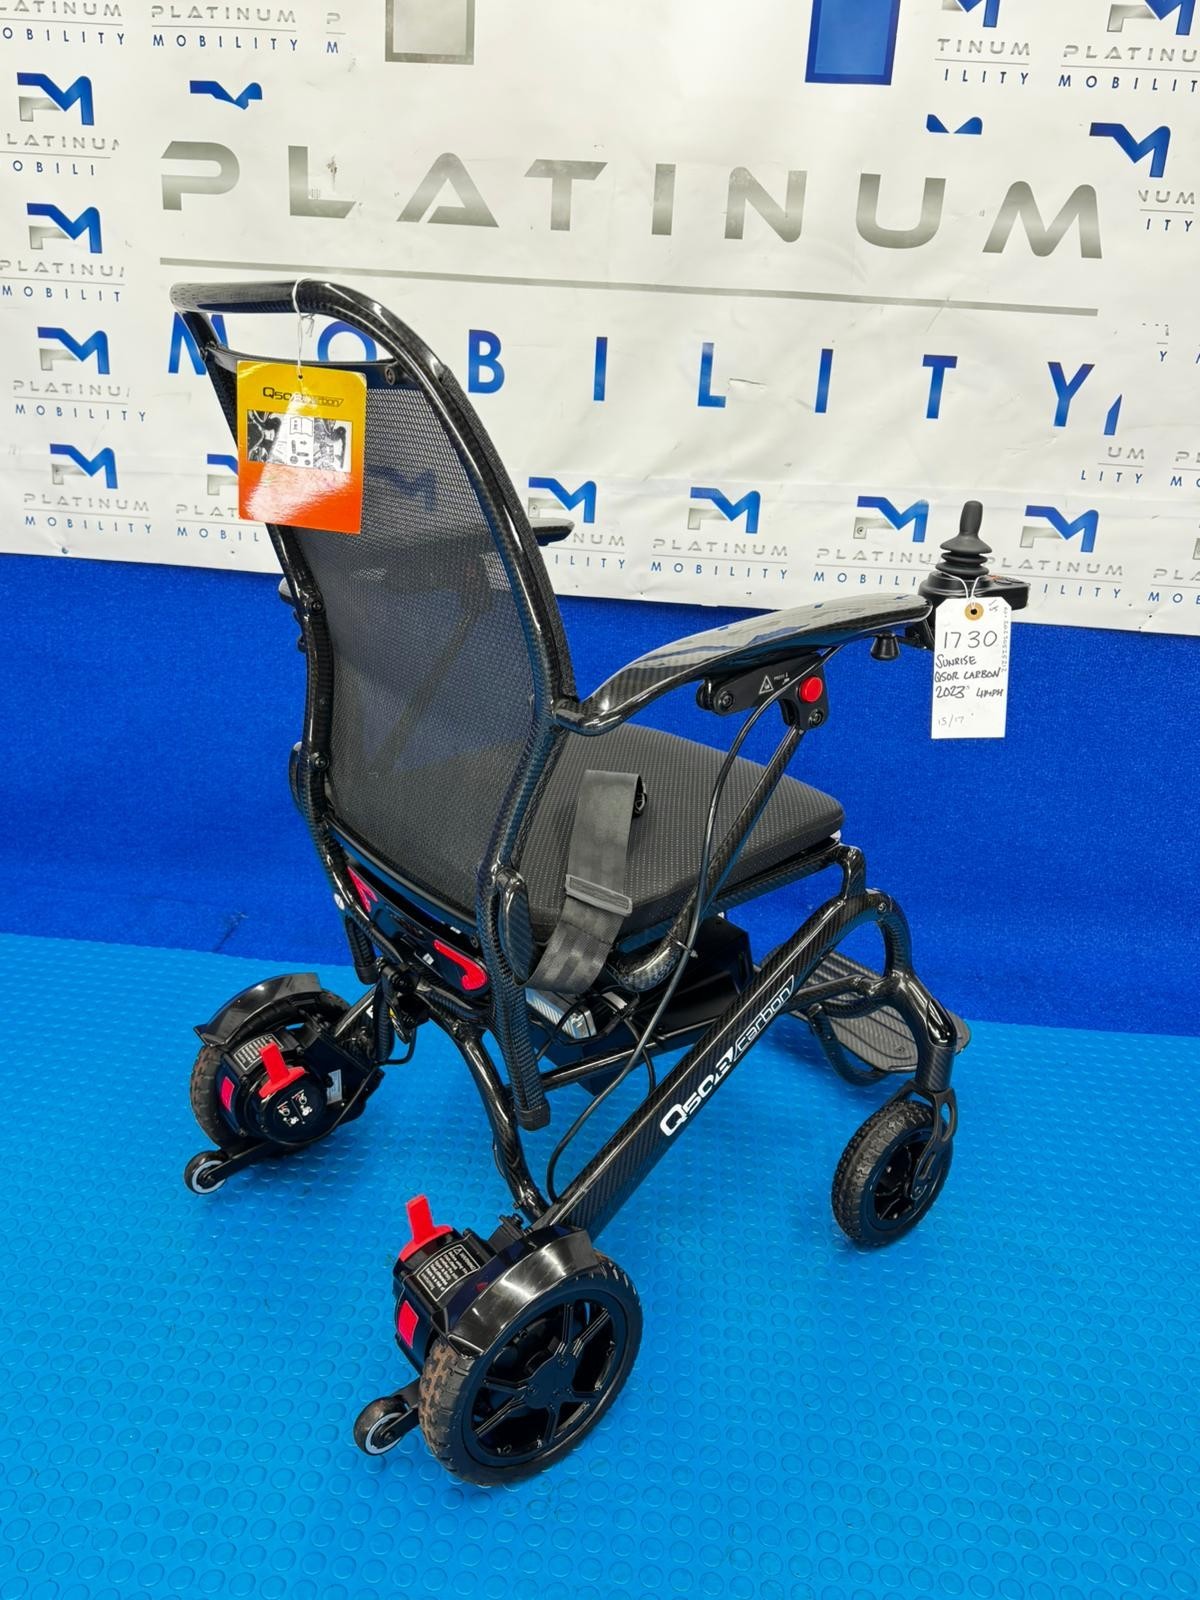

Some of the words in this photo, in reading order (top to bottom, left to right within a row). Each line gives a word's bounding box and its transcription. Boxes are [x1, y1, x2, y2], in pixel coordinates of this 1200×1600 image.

[151, 5, 296, 23] PLATINUM
[2, 27, 125, 46] OBILITY
[153, 34, 298, 51] MOBILITY
[937, 38, 1031, 56] TINUM
[944, 67, 1030, 85] ILITY
[1058, 74, 1198, 93] MOBILIT
[13, 160, 95, 176] OBILI
[160, 140, 1102, 259] PLATINUM
[1145, 218, 1194, 233] ITY
[2, 285, 121, 303] MOBILIT
[15, 404, 147, 422] MOBILITY
[24, 493, 150, 513] PLATINUM
[25, 515, 152, 534] MOBILITY
[652, 538, 788, 558] PLATINUM
[650, 560, 788, 580] MOBILITY
[943, 630, 998, 650] 1730
[963, 667, 1002, 681] CARBON
